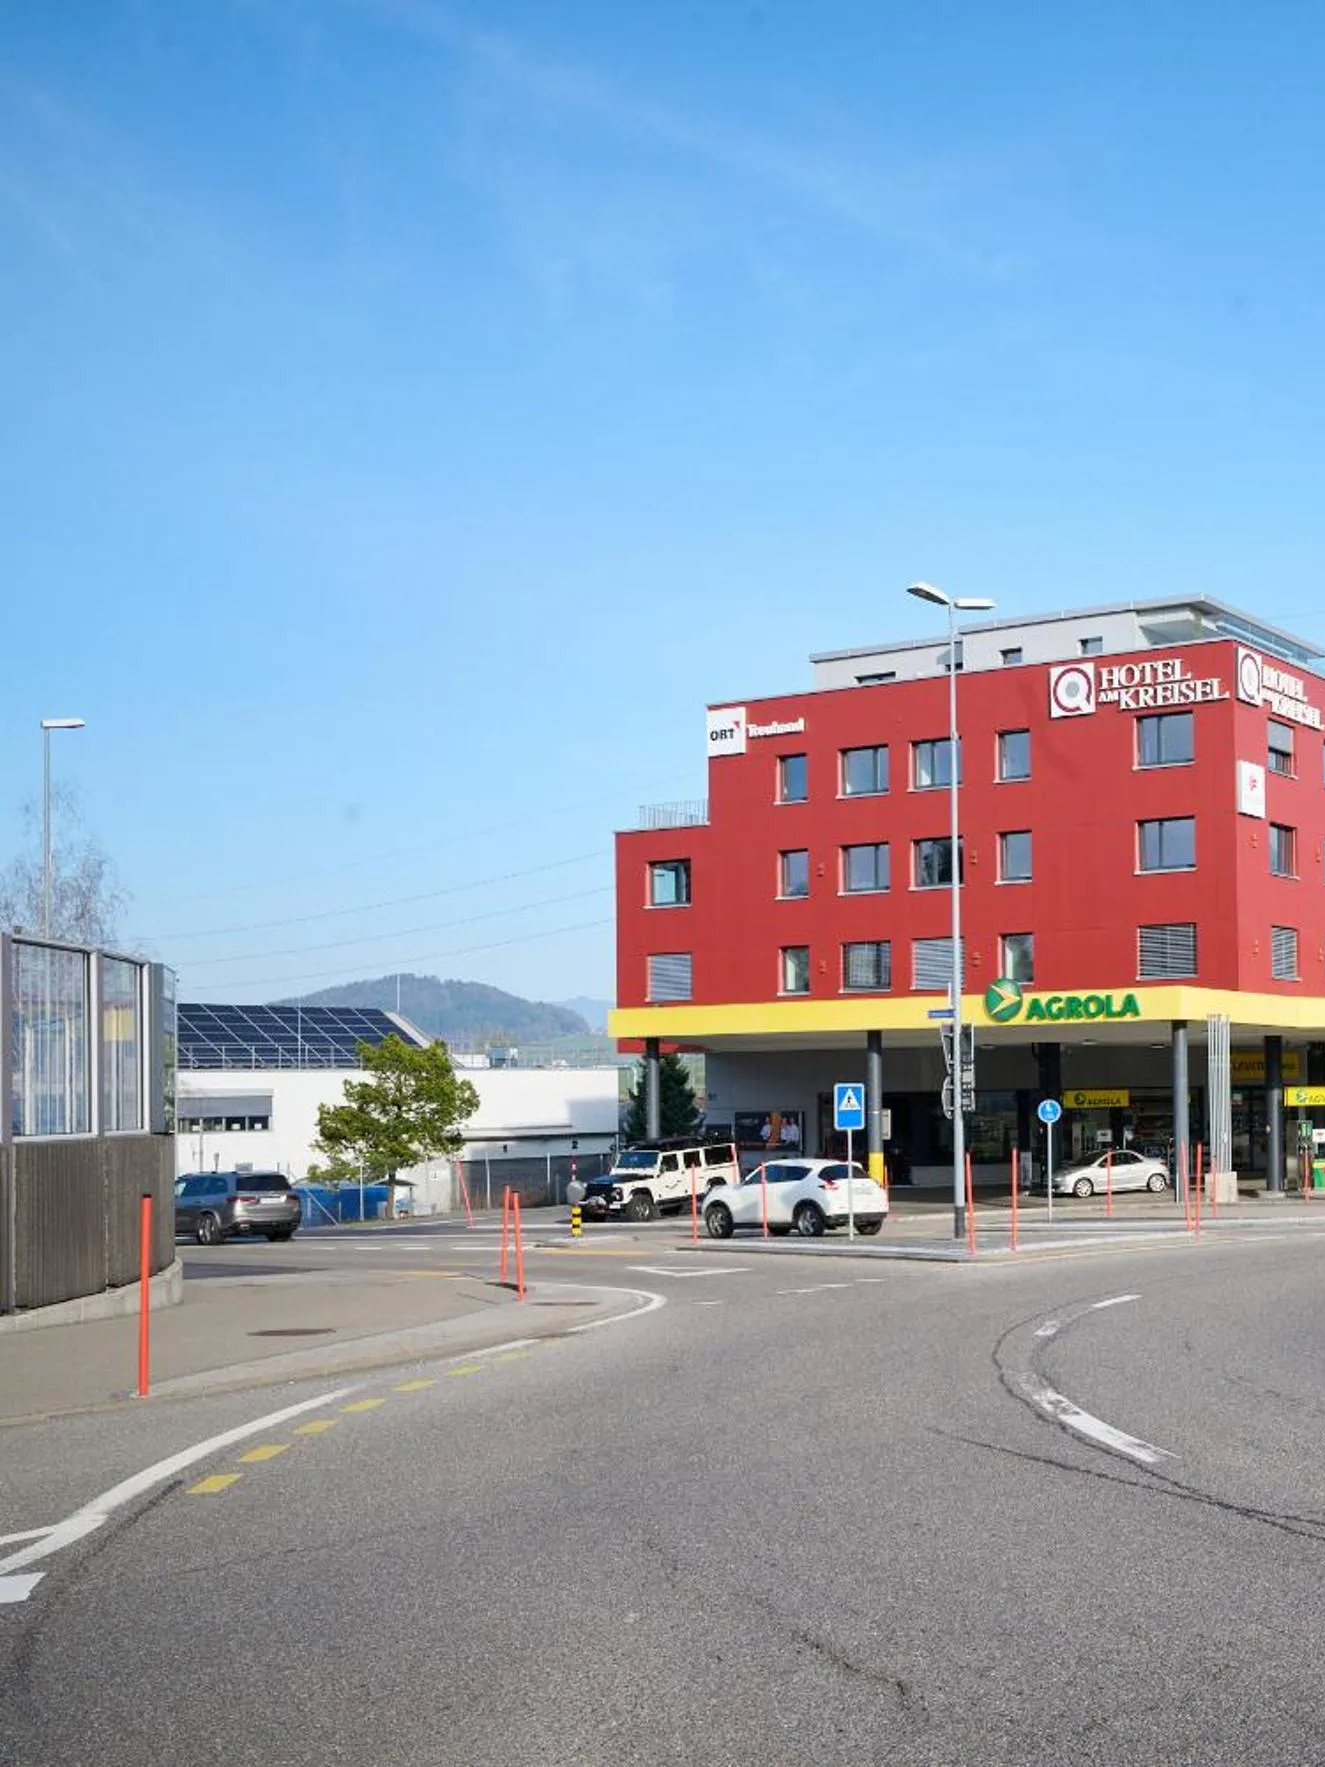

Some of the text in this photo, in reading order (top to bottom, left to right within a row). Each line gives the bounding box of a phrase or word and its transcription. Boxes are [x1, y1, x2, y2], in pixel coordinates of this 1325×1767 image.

[1099, 658, 1192, 690] HOTEL
[1098, 677, 1230, 710] AM KREISEL
[1025, 993, 1141, 1021] AGROLA
